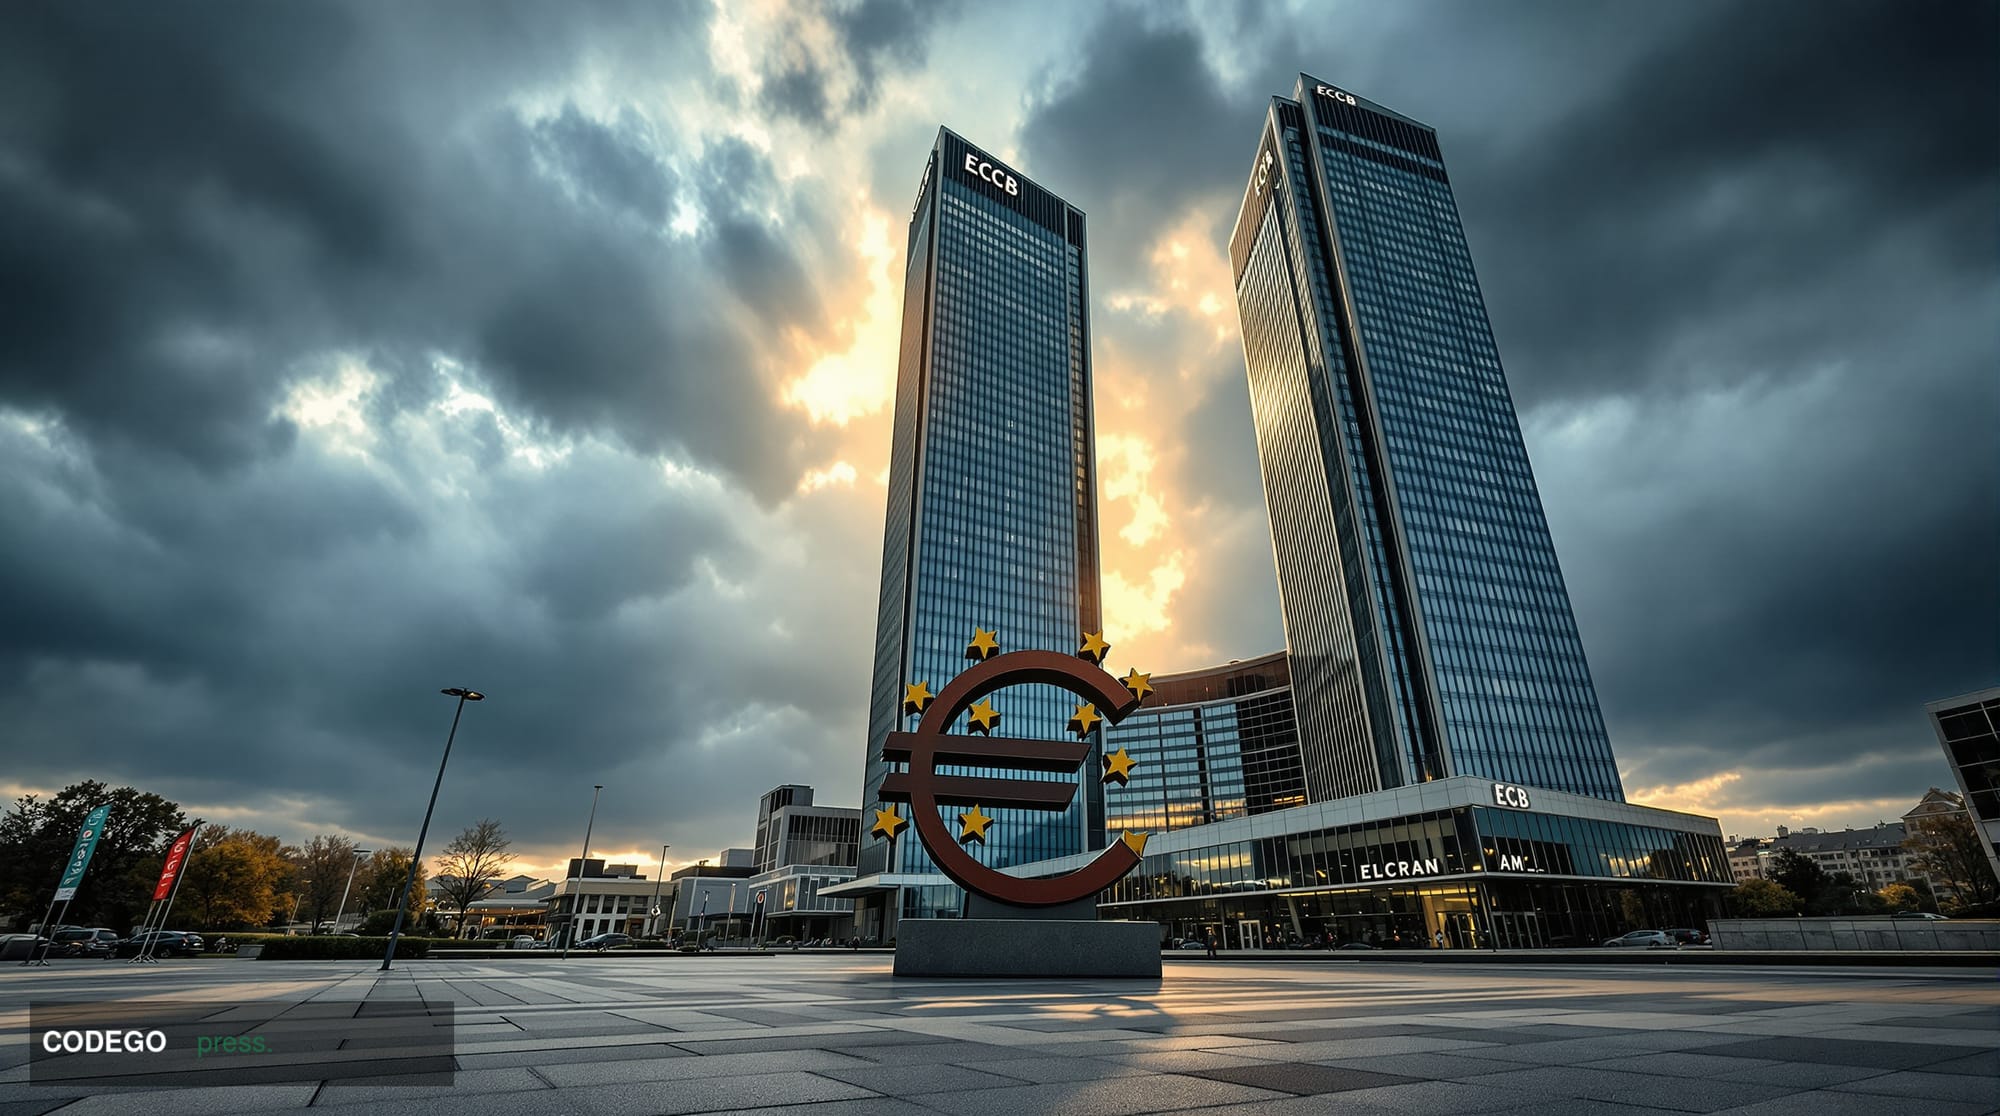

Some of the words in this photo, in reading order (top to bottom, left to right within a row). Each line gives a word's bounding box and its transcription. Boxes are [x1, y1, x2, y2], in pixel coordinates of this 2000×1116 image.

[1316, 84, 1357, 107] ECCB
[964, 152, 1018, 197] ECCB
[1494, 783, 1530, 808] ECB
[1359, 858, 1439, 880] ELCRAN
